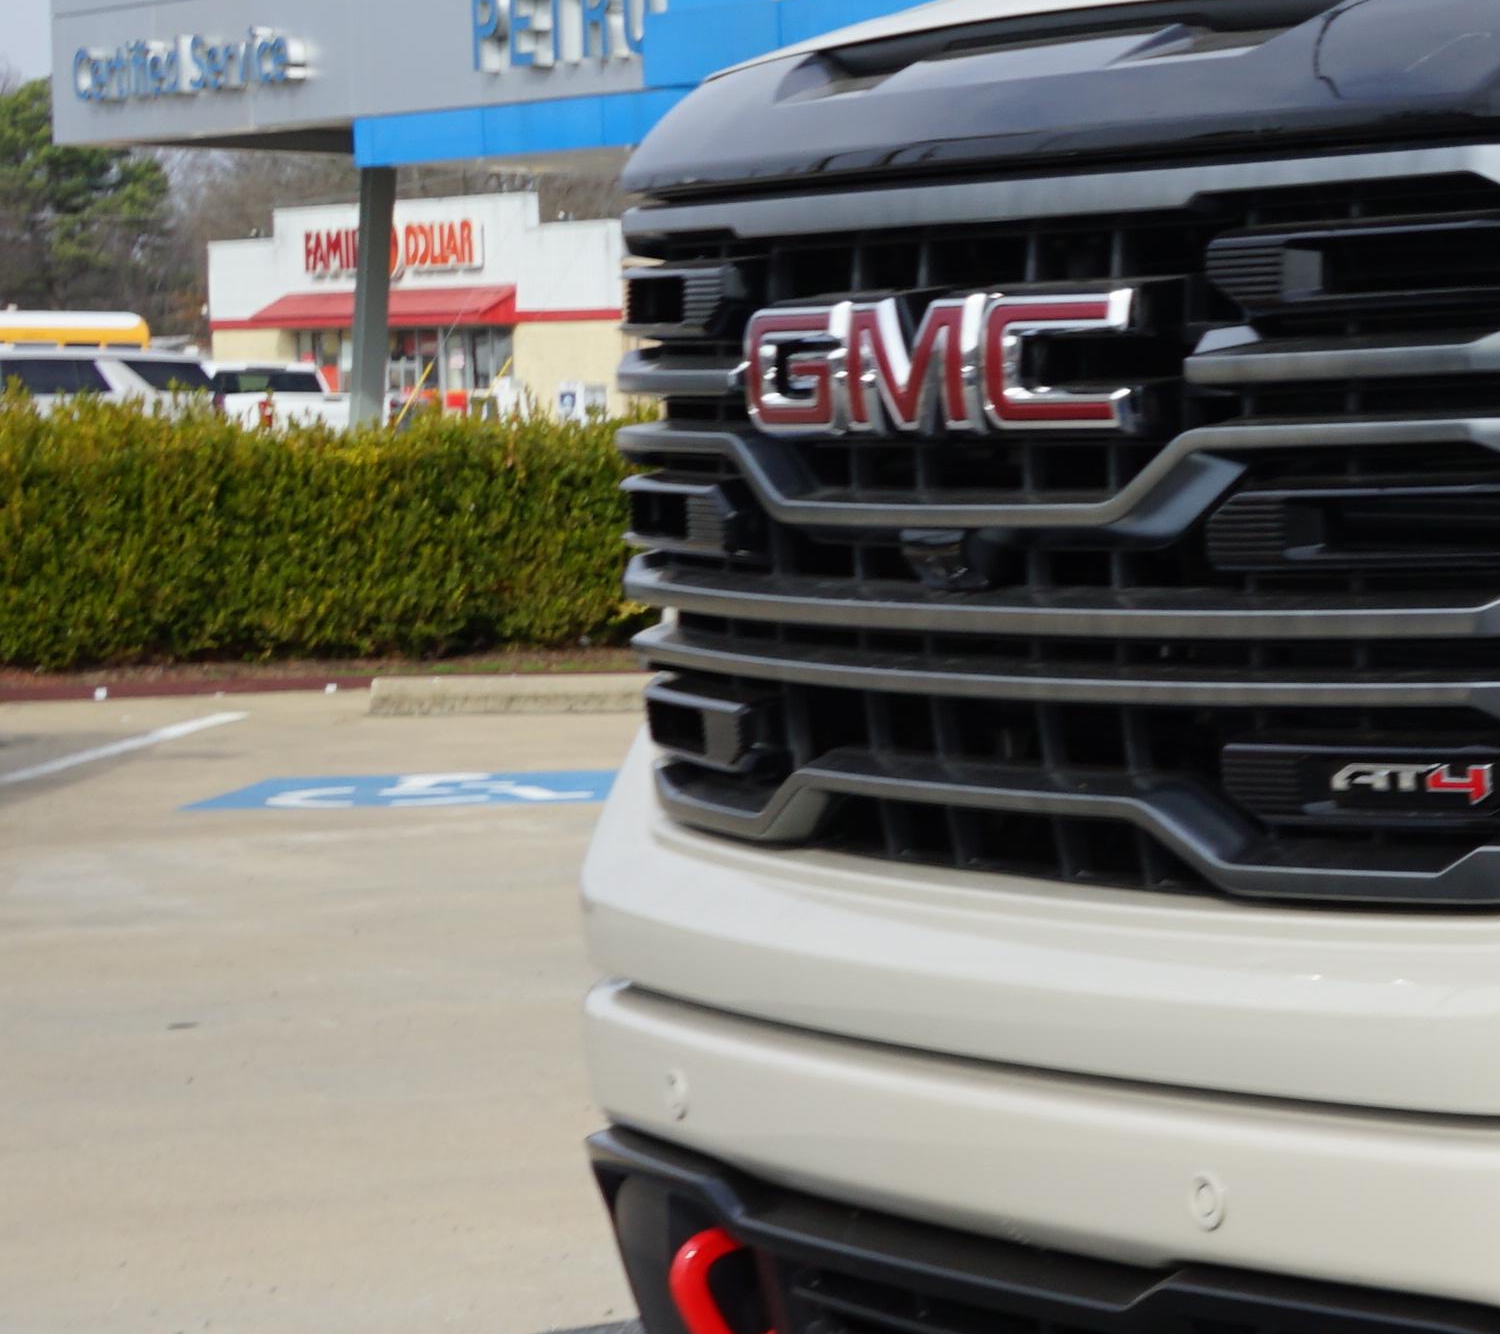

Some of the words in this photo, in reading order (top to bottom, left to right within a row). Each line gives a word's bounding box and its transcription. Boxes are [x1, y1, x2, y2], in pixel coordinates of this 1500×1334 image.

[73, 39, 179, 101] Certified
[190, 24, 289, 89] Service
[404, 219, 473, 267] DOLLAR
[744, 287, 1134, 434] GMC
[1331, 762, 1494, 806] AT4
